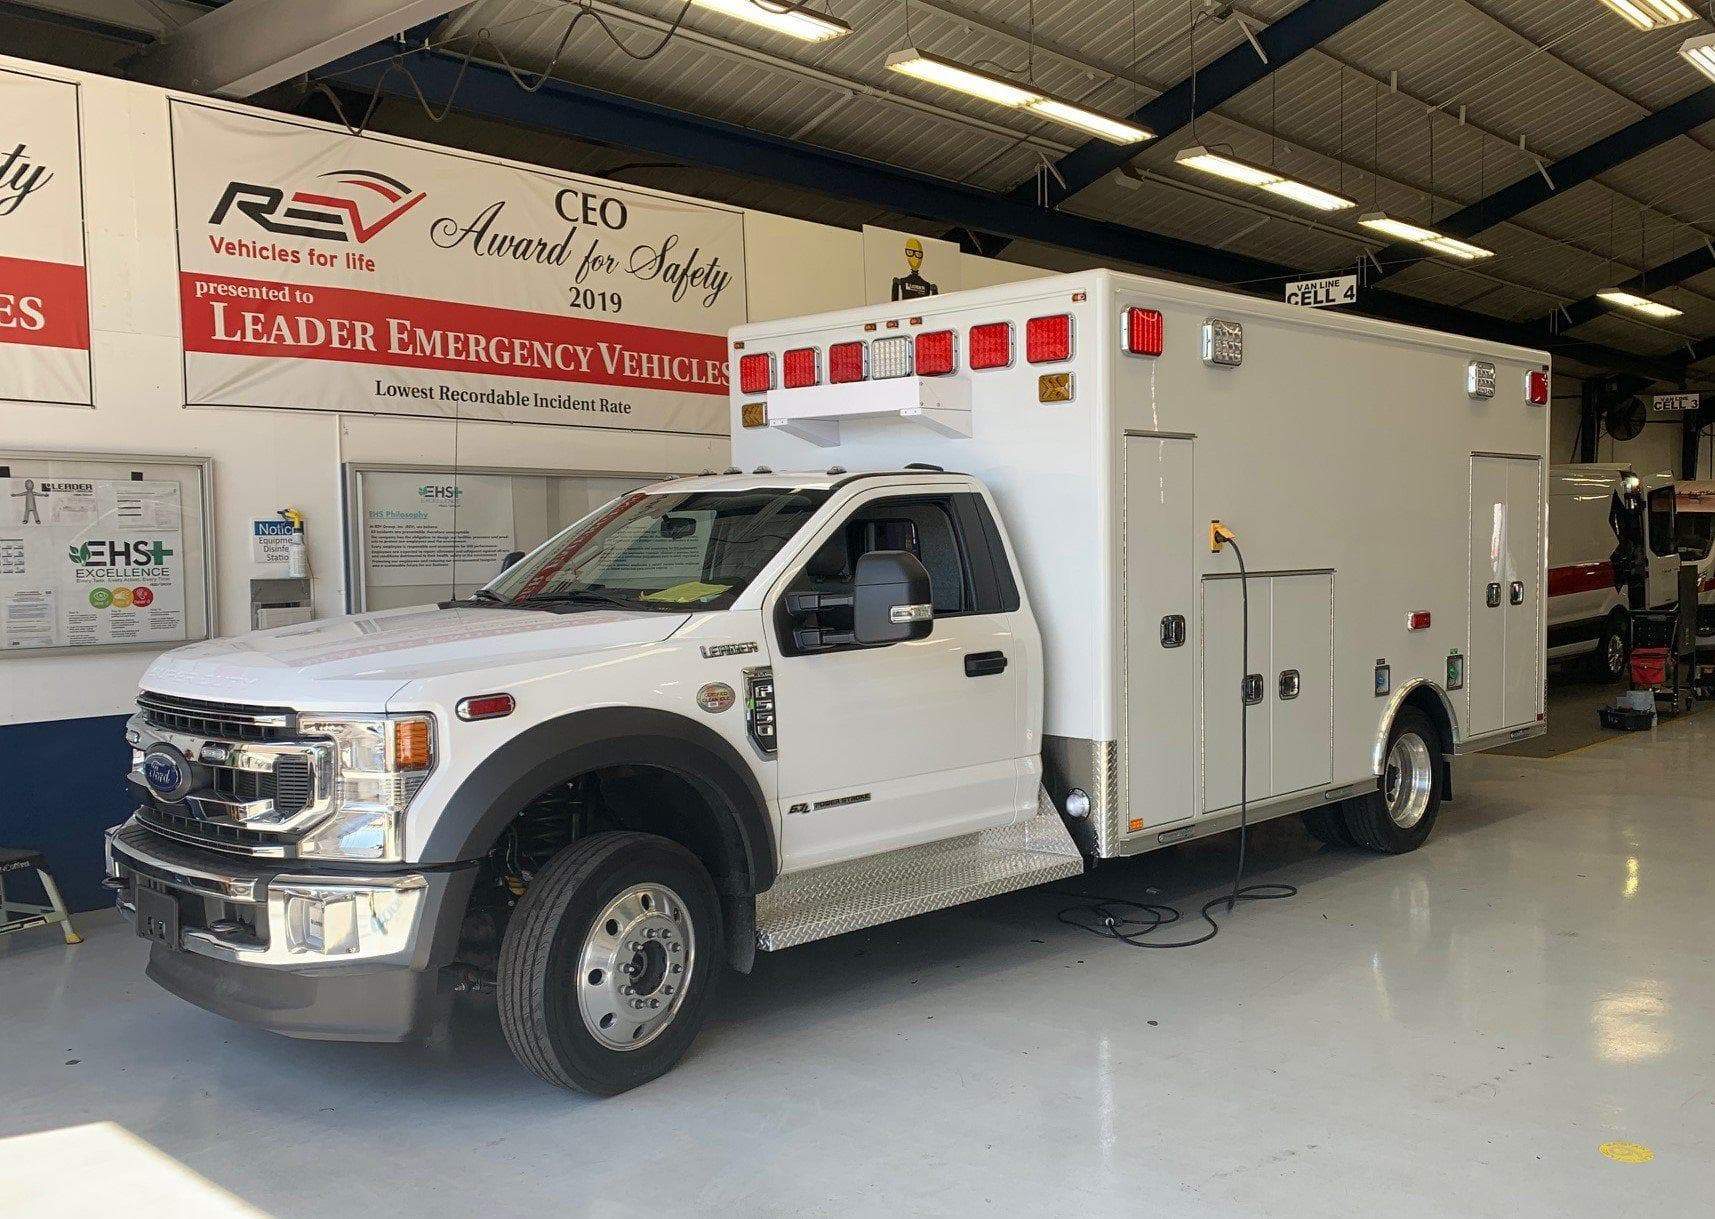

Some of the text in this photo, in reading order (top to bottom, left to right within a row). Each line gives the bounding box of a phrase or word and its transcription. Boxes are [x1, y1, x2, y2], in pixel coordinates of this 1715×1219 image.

[208, 181, 427, 244] REV
[555, 188, 628, 230] CEO
[208, 235, 376, 272] Vehicles for life
[430, 201, 733, 308] Award for Safety
[195, 280, 314, 305] presented to
[1287, 285, 1355, 306] CELL 4
[1297, 280, 1340, 291] VAN LINE
[569, 286, 622, 313] 2019
[210, 301, 730, 387] LEADER EMERGENCY VEHICLES
[375, 380, 632, 414] Lowest Recordable Incident Rate
[1654, 399, 1699, 411] CELL 3
[386, 510, 429, 519] Philosophy
[259, 523, 292, 535] Notic
[259, 537, 293, 545] Equipme
[264, 545, 289, 553] Disinfe
[267, 553, 289, 562] Statio
[76, 567, 170, 578] EXCELLENCE
